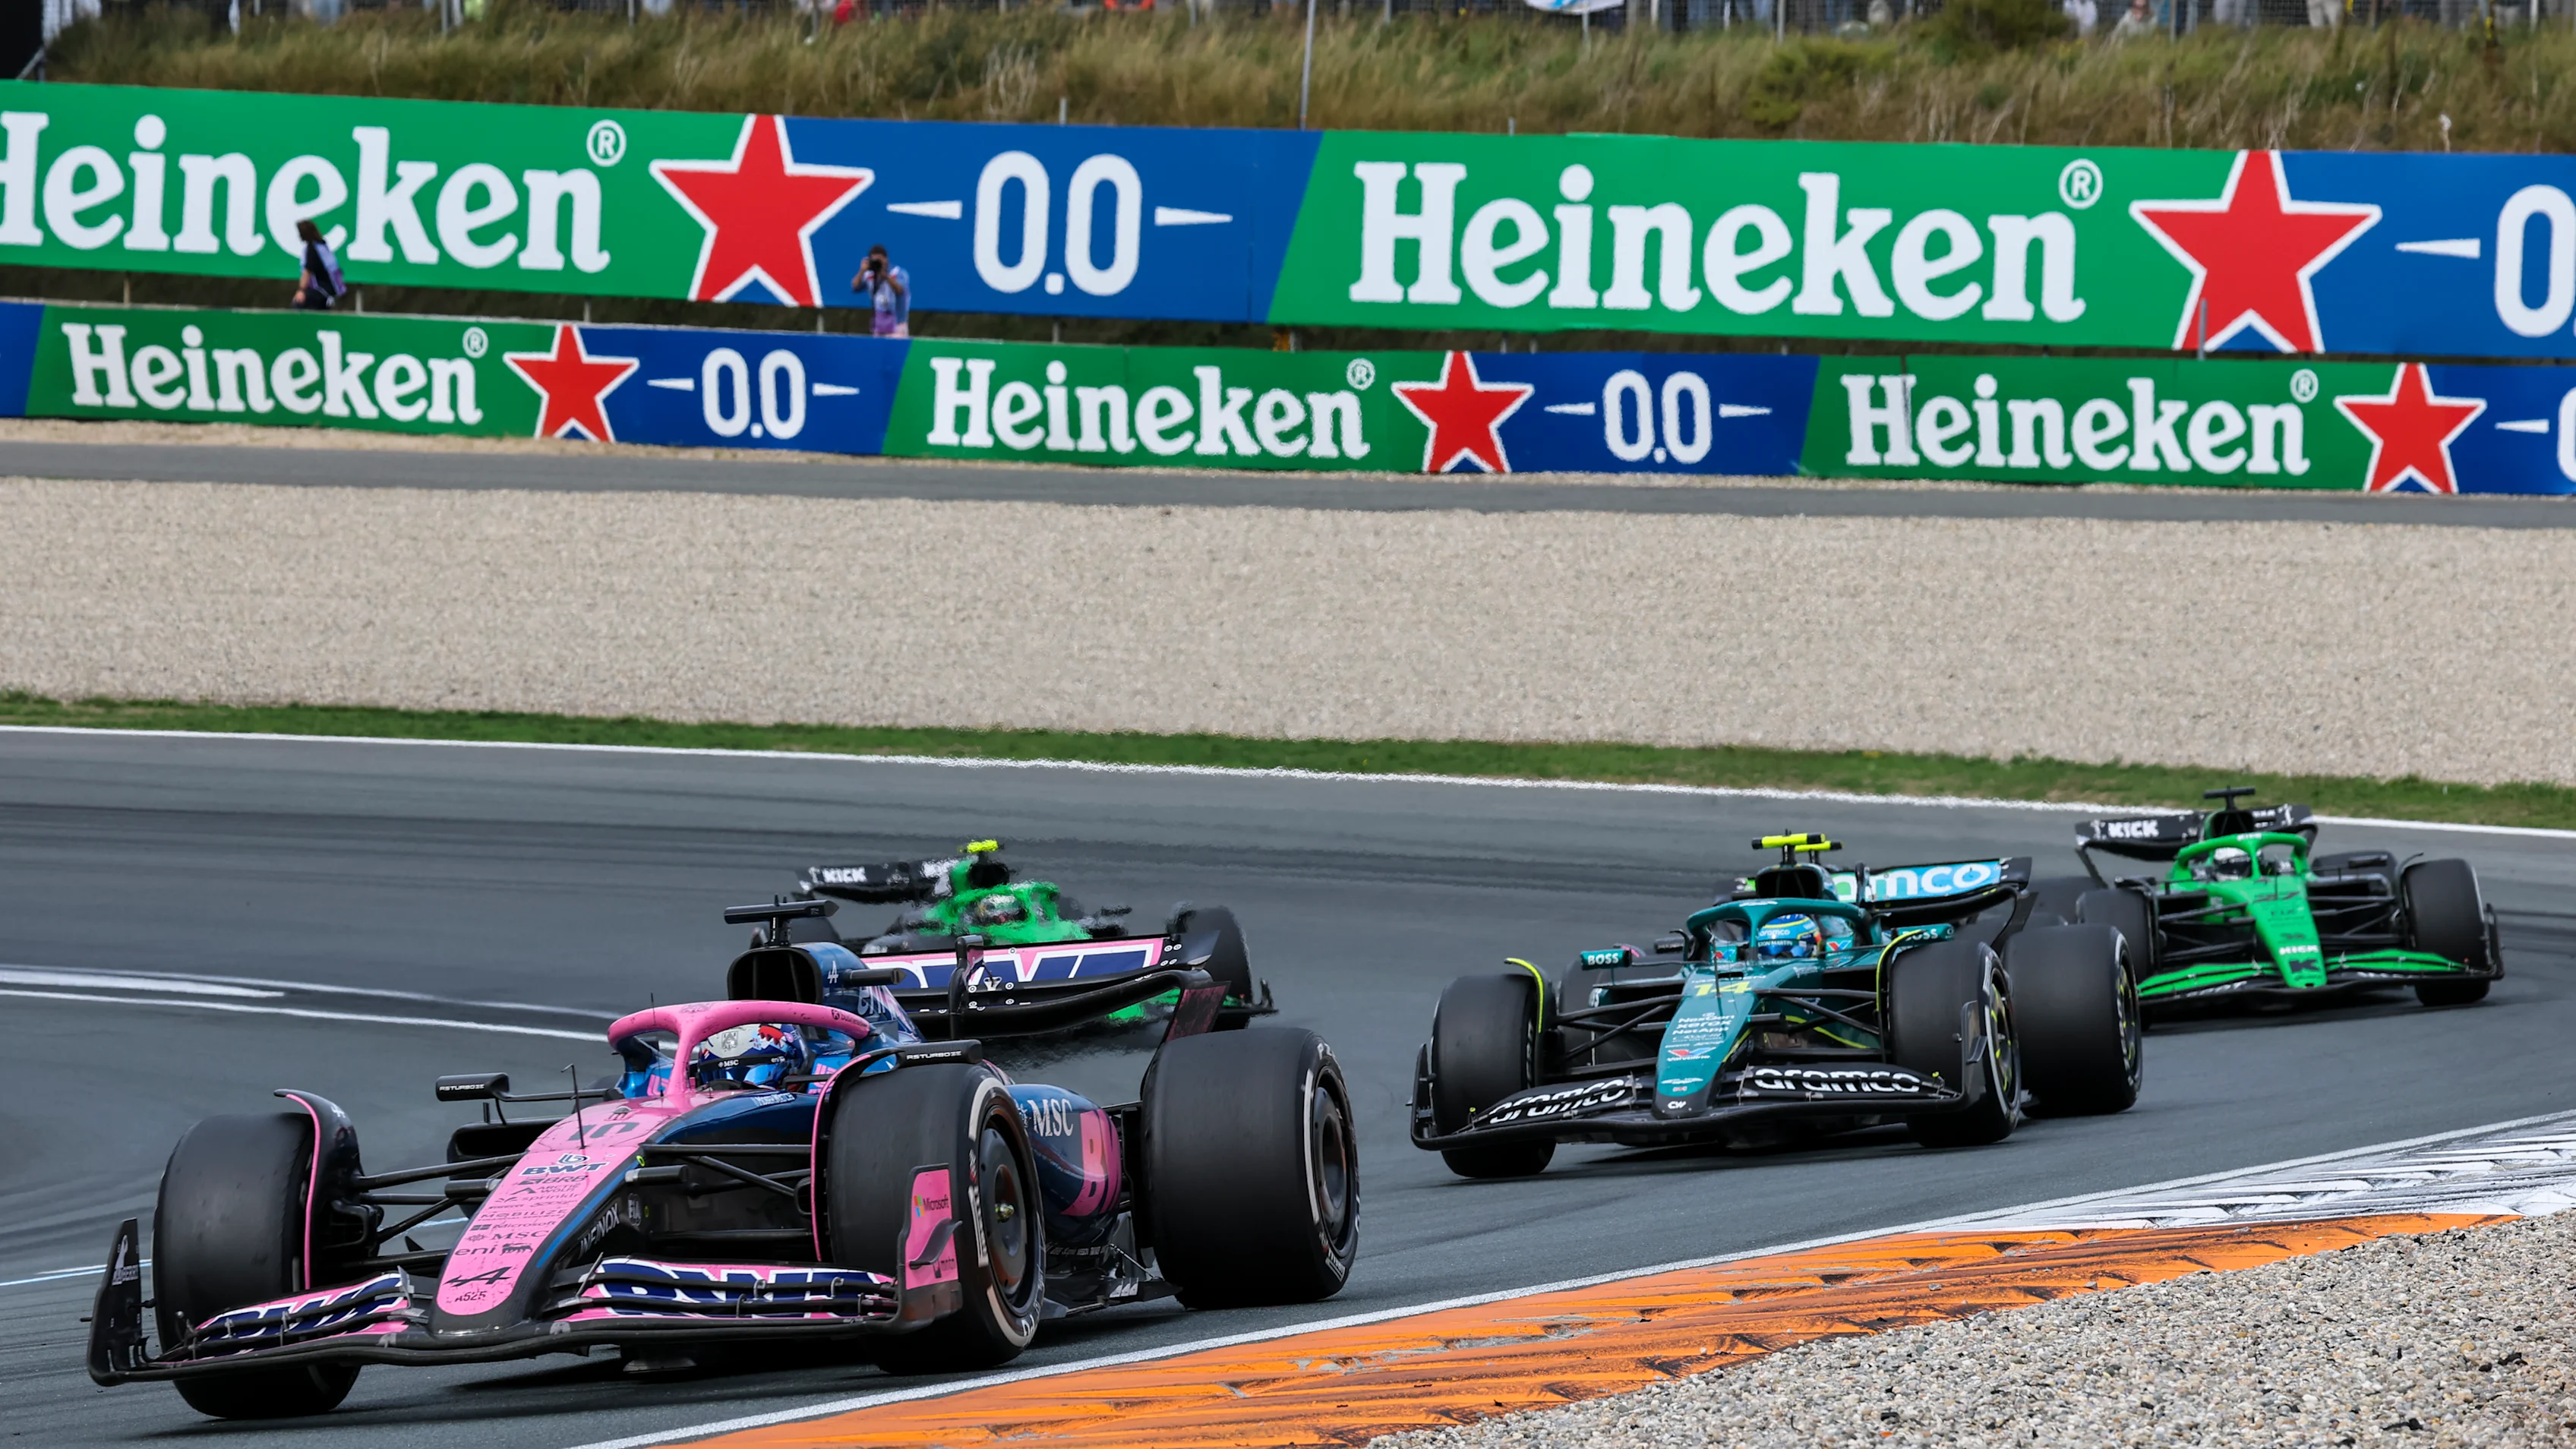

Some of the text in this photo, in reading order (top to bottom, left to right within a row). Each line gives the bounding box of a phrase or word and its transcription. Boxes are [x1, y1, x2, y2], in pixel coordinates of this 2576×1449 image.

[2108, 819, 2160, 838] KICK
[822, 866, 867, 883] KICK
[1587, 952, 1619, 965] BOSS
[1694, 980, 1753, 996] 14
[1027, 1098, 1074, 1137] MSC
[519, 1162, 610, 1176] BWT
[923, 1193, 950, 1211] Microsoft
[492, 1220, 556, 1229] Microsoft
[490, 1230, 550, 1240] MSC
[454, 1244, 499, 1256] eni
